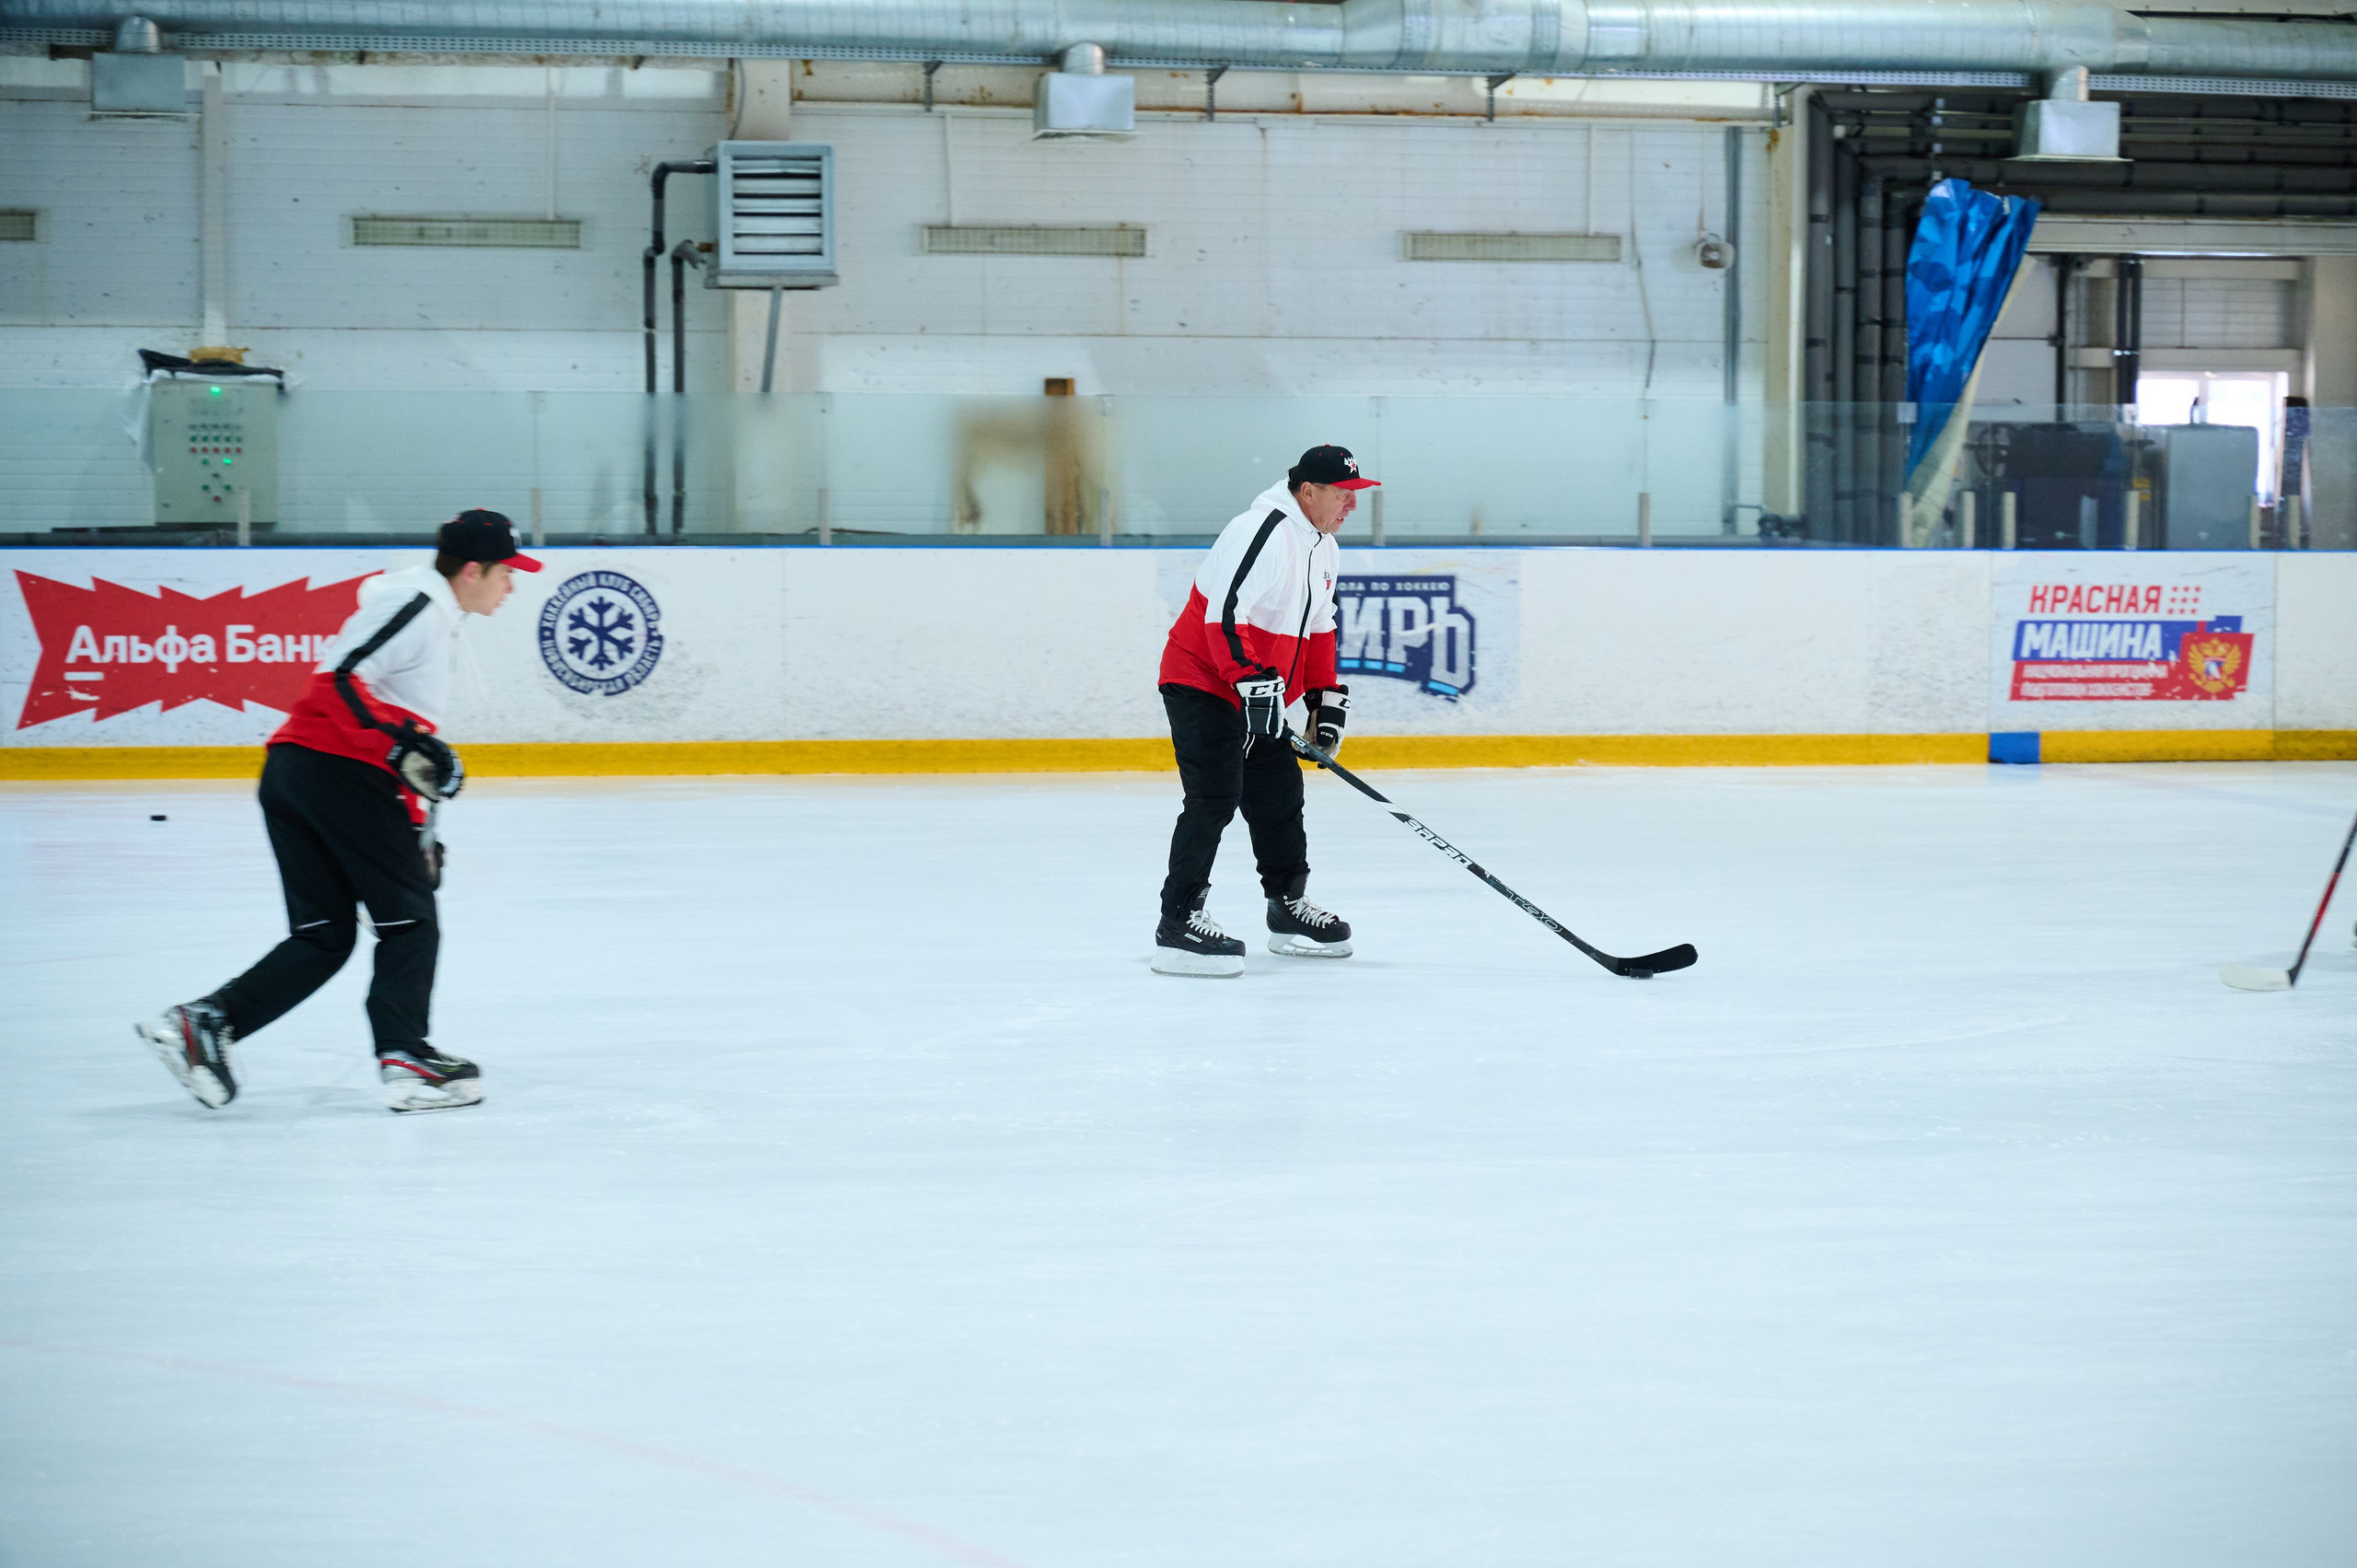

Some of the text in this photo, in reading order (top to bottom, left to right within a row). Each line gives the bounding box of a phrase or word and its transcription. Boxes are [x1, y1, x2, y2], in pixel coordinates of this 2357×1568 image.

[1395, 581, 1451, 592] ХОККЕЮ
[2028, 584, 2163, 614] КРАСНАЯ
[64, 624, 217, 674] Альфа
[1338, 596, 1471, 690] ИРЬ
[2020, 622, 2163, 659] МАШИНА
